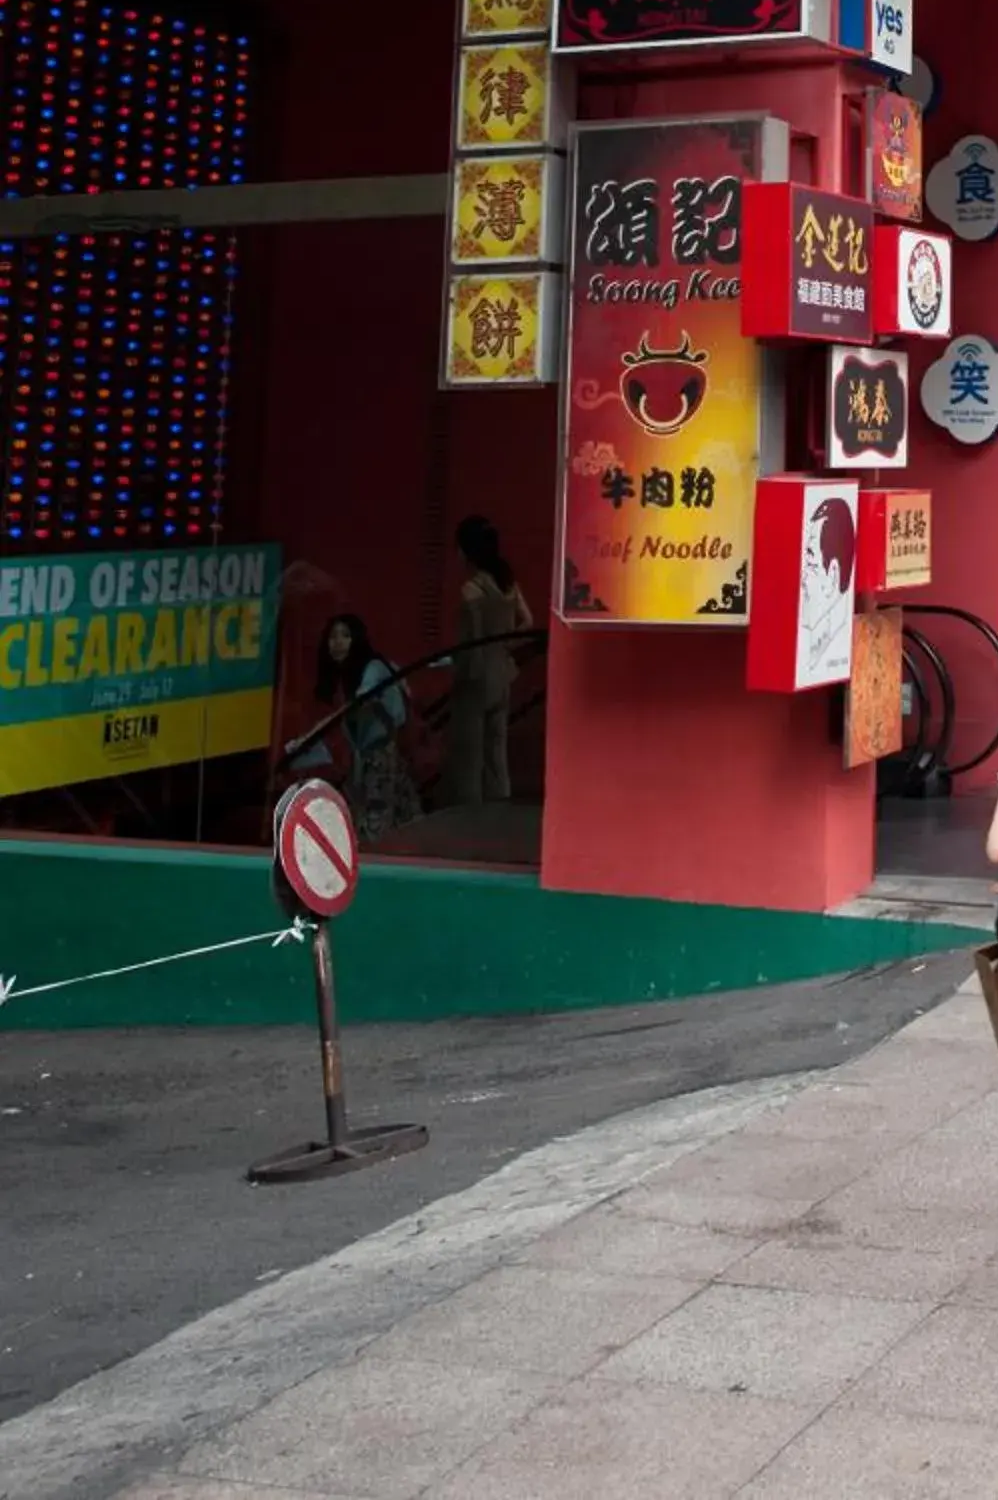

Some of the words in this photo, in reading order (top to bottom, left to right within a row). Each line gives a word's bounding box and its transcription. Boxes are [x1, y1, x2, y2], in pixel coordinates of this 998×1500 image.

[876, 0, 903, 36] yes
[955, 162, 995, 204] 食
[588, 272, 679, 308] Soong
[950, 361, 990, 405] 笑
[600, 466, 717, 510] 牛肉粉
[640, 534, 733, 562] Noodle
[90, 561, 135, 607] OF
[142, 552, 266, 604] SEASON
[1, 601, 261, 690] CLEARANCE
